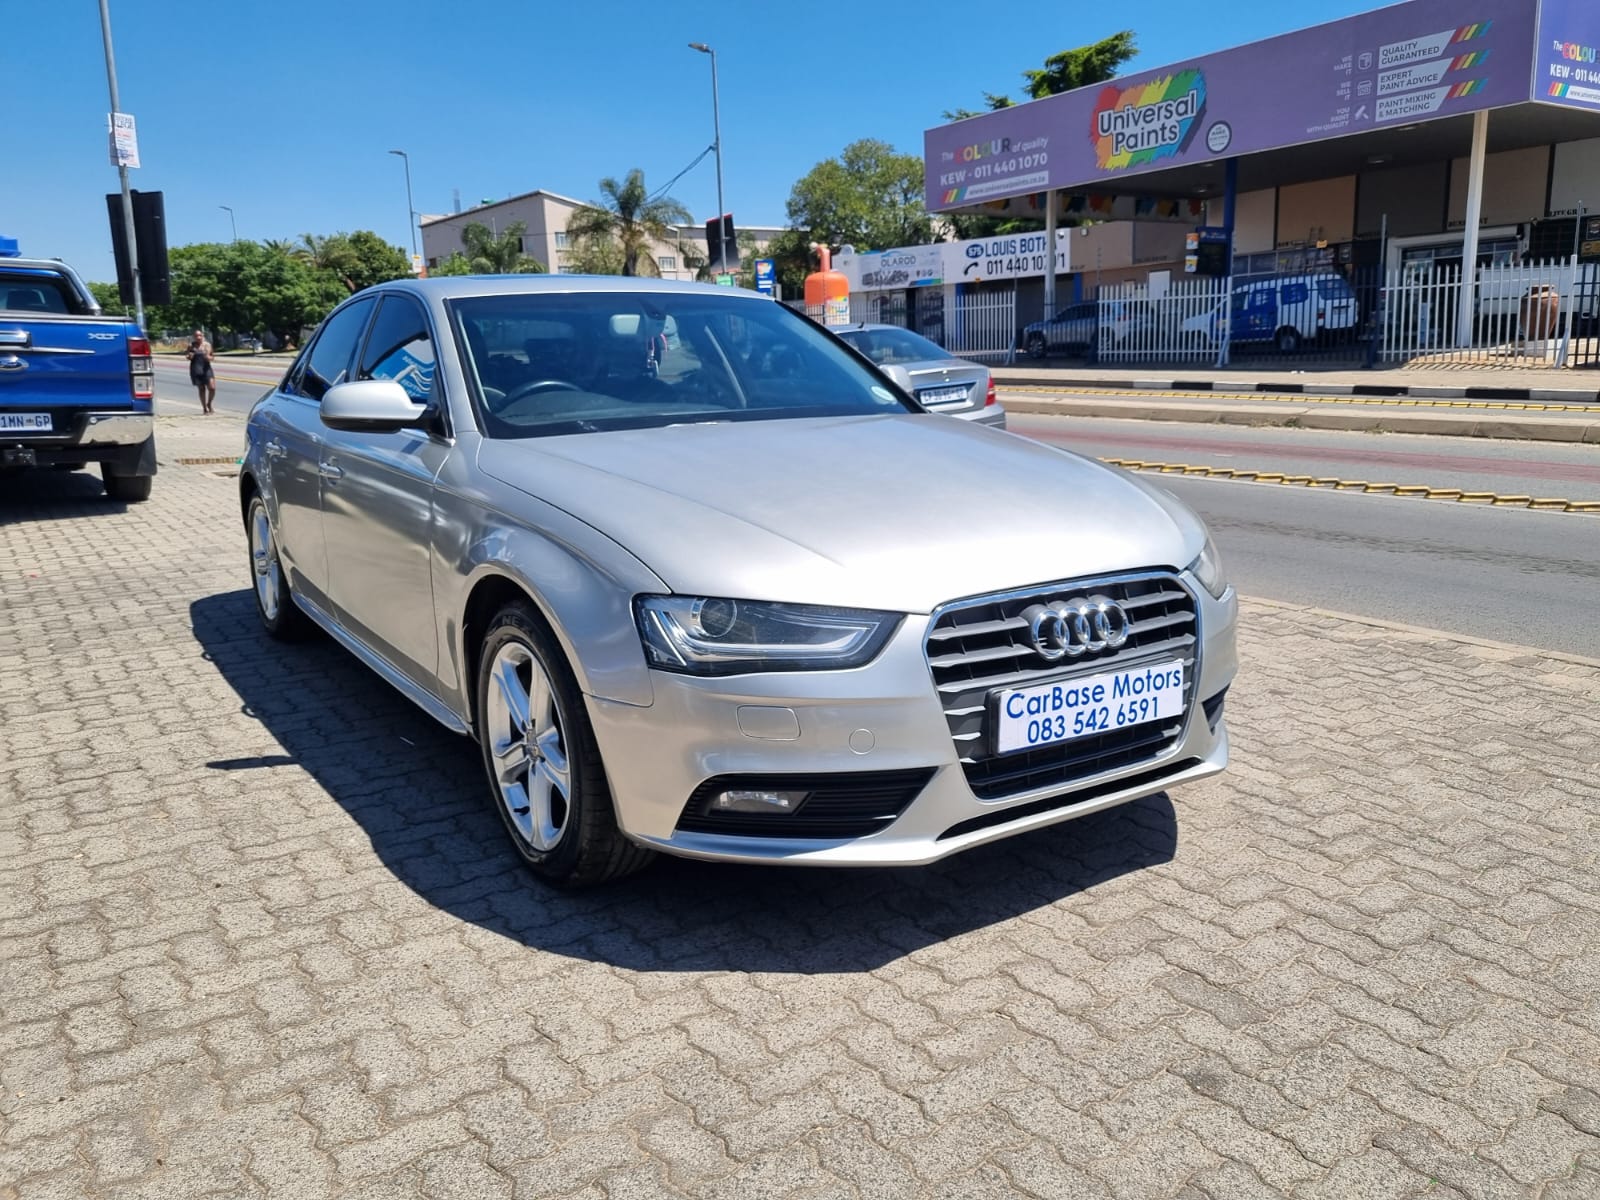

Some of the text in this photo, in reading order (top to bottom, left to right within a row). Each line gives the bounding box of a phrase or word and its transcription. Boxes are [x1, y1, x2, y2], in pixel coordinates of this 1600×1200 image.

[1381, 41, 1418, 57] QUALITY
[1553, 40, 1563, 51] The
[1381, 46, 1440, 65] GUARANTEED
[1380, 70, 1413, 83] EXPERT
[1380, 73, 1438, 91] PAINT ADVICE
[1550, 63, 1570, 78] KEW
[1575, 68, 1587, 82] 011
[1378, 92, 1436, 110] PAINT MIXING
[1384, 102, 1431, 117] MATCHING
[1100, 92, 1195, 134] Universal
[1114, 121, 1178, 153] Paints
[942, 151, 954, 162] The
[954, 138, 1010, 164] COLOUR
[1021, 137, 1049, 152] quality
[940, 170, 966, 186] KEW
[974, 164, 991, 178] 011
[993, 159, 1016, 174] 440
[1018, 153, 1048, 170] 1070
[985, 240, 1016, 257] LOUIS
[1019, 235, 1057, 253] BOTH
[987, 260, 1003, 275] 011
[1006, 257, 1028, 273] 440
[35, 414, 50, 427] GP
[1006, 669, 1181, 719] CarBase Motors
[1027, 696, 1158, 744] 083 542 6591
